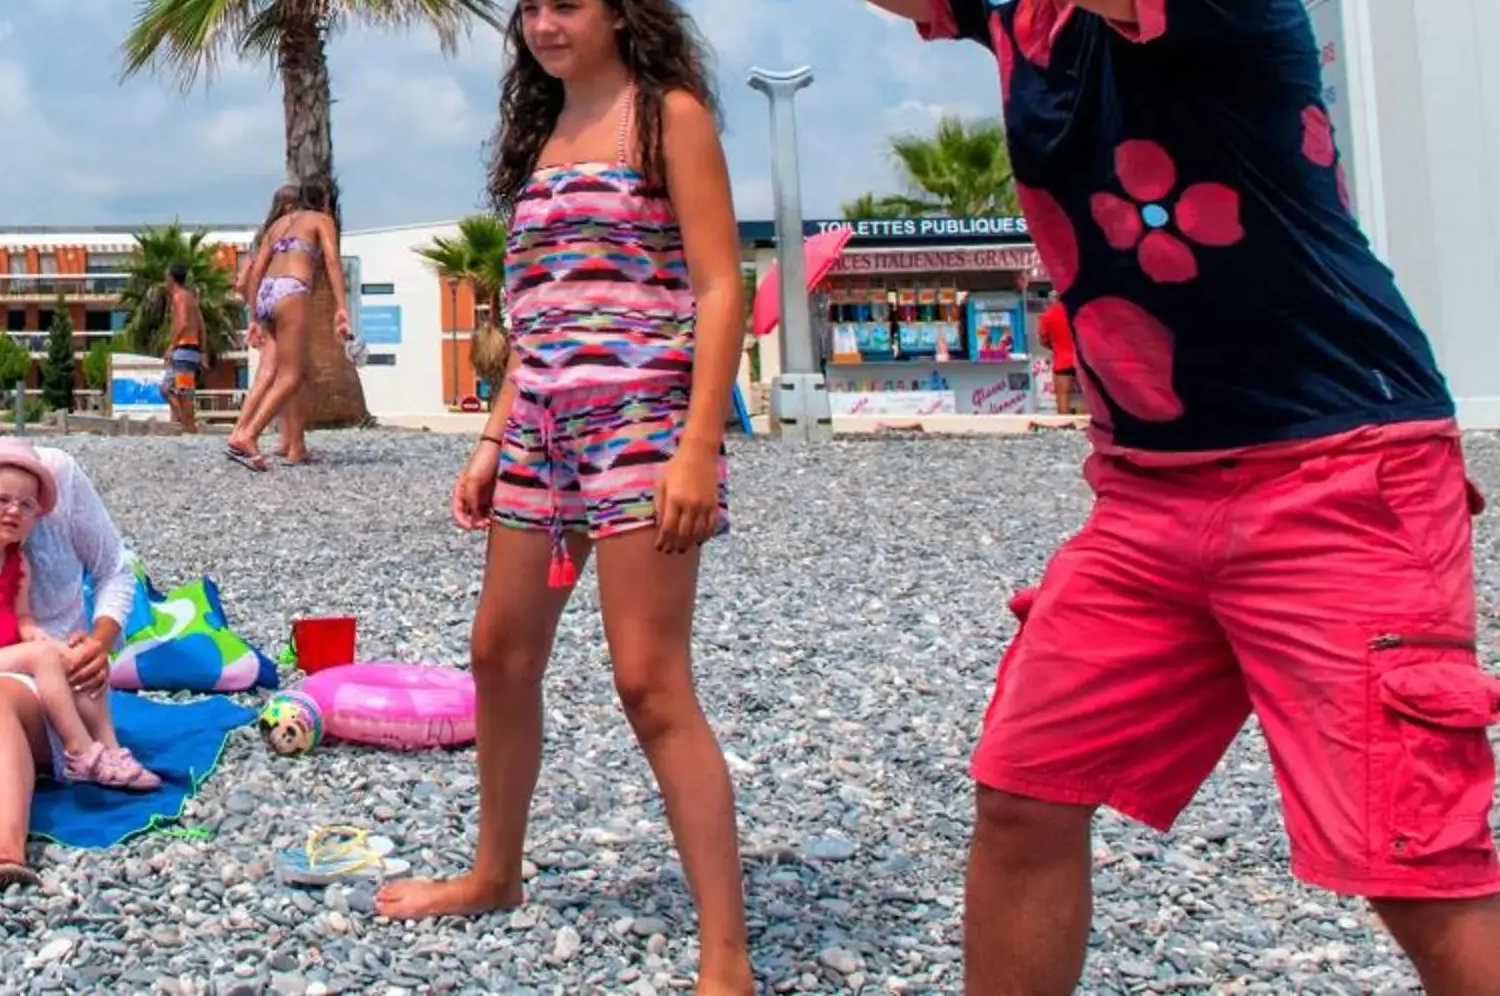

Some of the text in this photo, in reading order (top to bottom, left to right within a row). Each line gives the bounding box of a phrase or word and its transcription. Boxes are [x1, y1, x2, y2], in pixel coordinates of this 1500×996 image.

[816, 217, 1029, 236] TOILETTES PUBLIQUES
[831, 254, 872, 270] ACES
